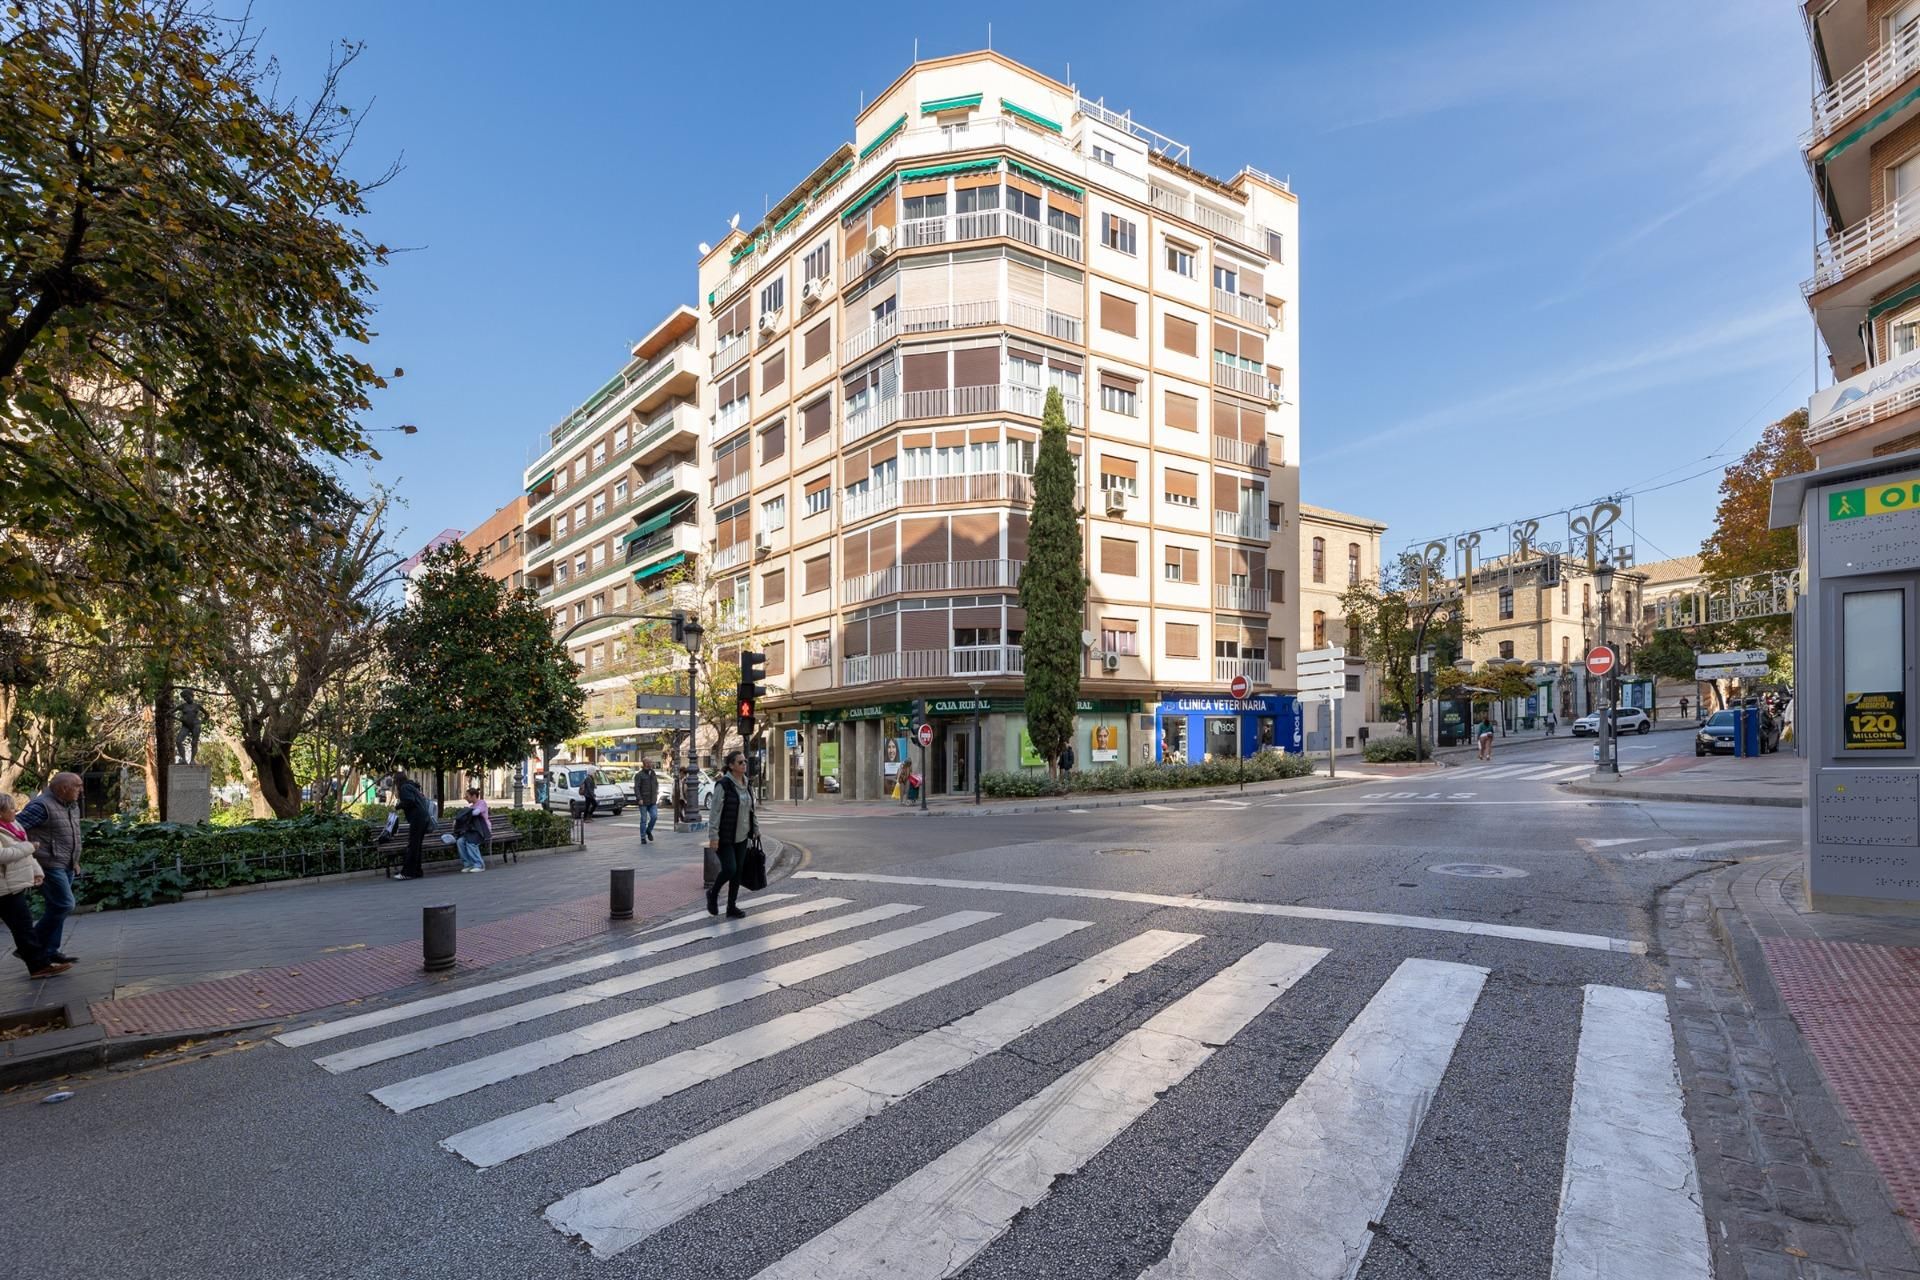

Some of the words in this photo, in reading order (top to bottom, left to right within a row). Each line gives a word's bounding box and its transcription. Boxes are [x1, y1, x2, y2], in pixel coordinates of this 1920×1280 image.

[935, 701, 957, 710] CAJA
[1076, 701, 1093, 710] RAL
[1179, 699, 1211, 711] CLINICA
[1214, 699, 1267, 711] VETERNARIA
[850, 708, 863, 717] CAJA
[863, 706, 882, 715] RURAL
[1850, 715, 1897, 733] 120
